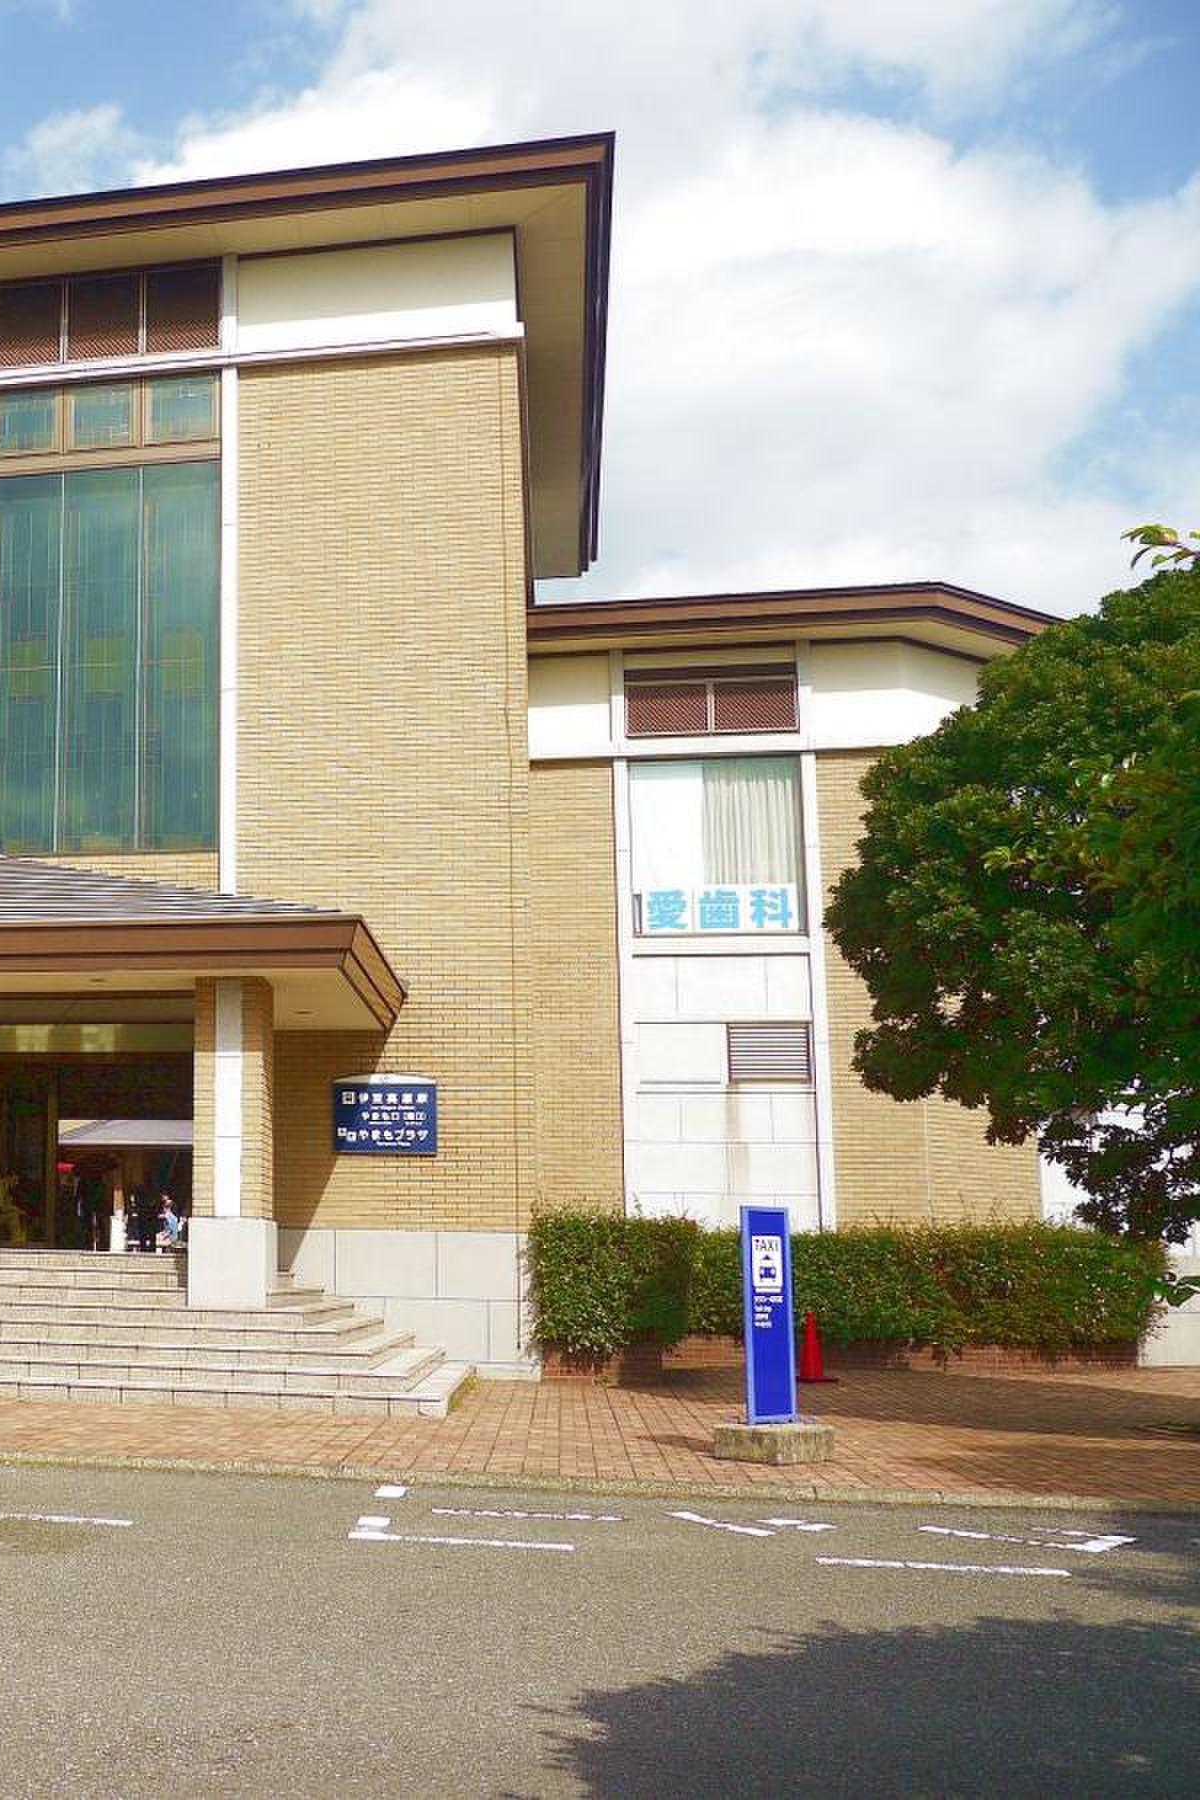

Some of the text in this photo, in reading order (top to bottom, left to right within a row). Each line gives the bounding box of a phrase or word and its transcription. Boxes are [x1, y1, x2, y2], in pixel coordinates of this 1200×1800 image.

[647, 888, 793, 929] 愛歯科
[754, 1238, 779, 1252] TAXI
